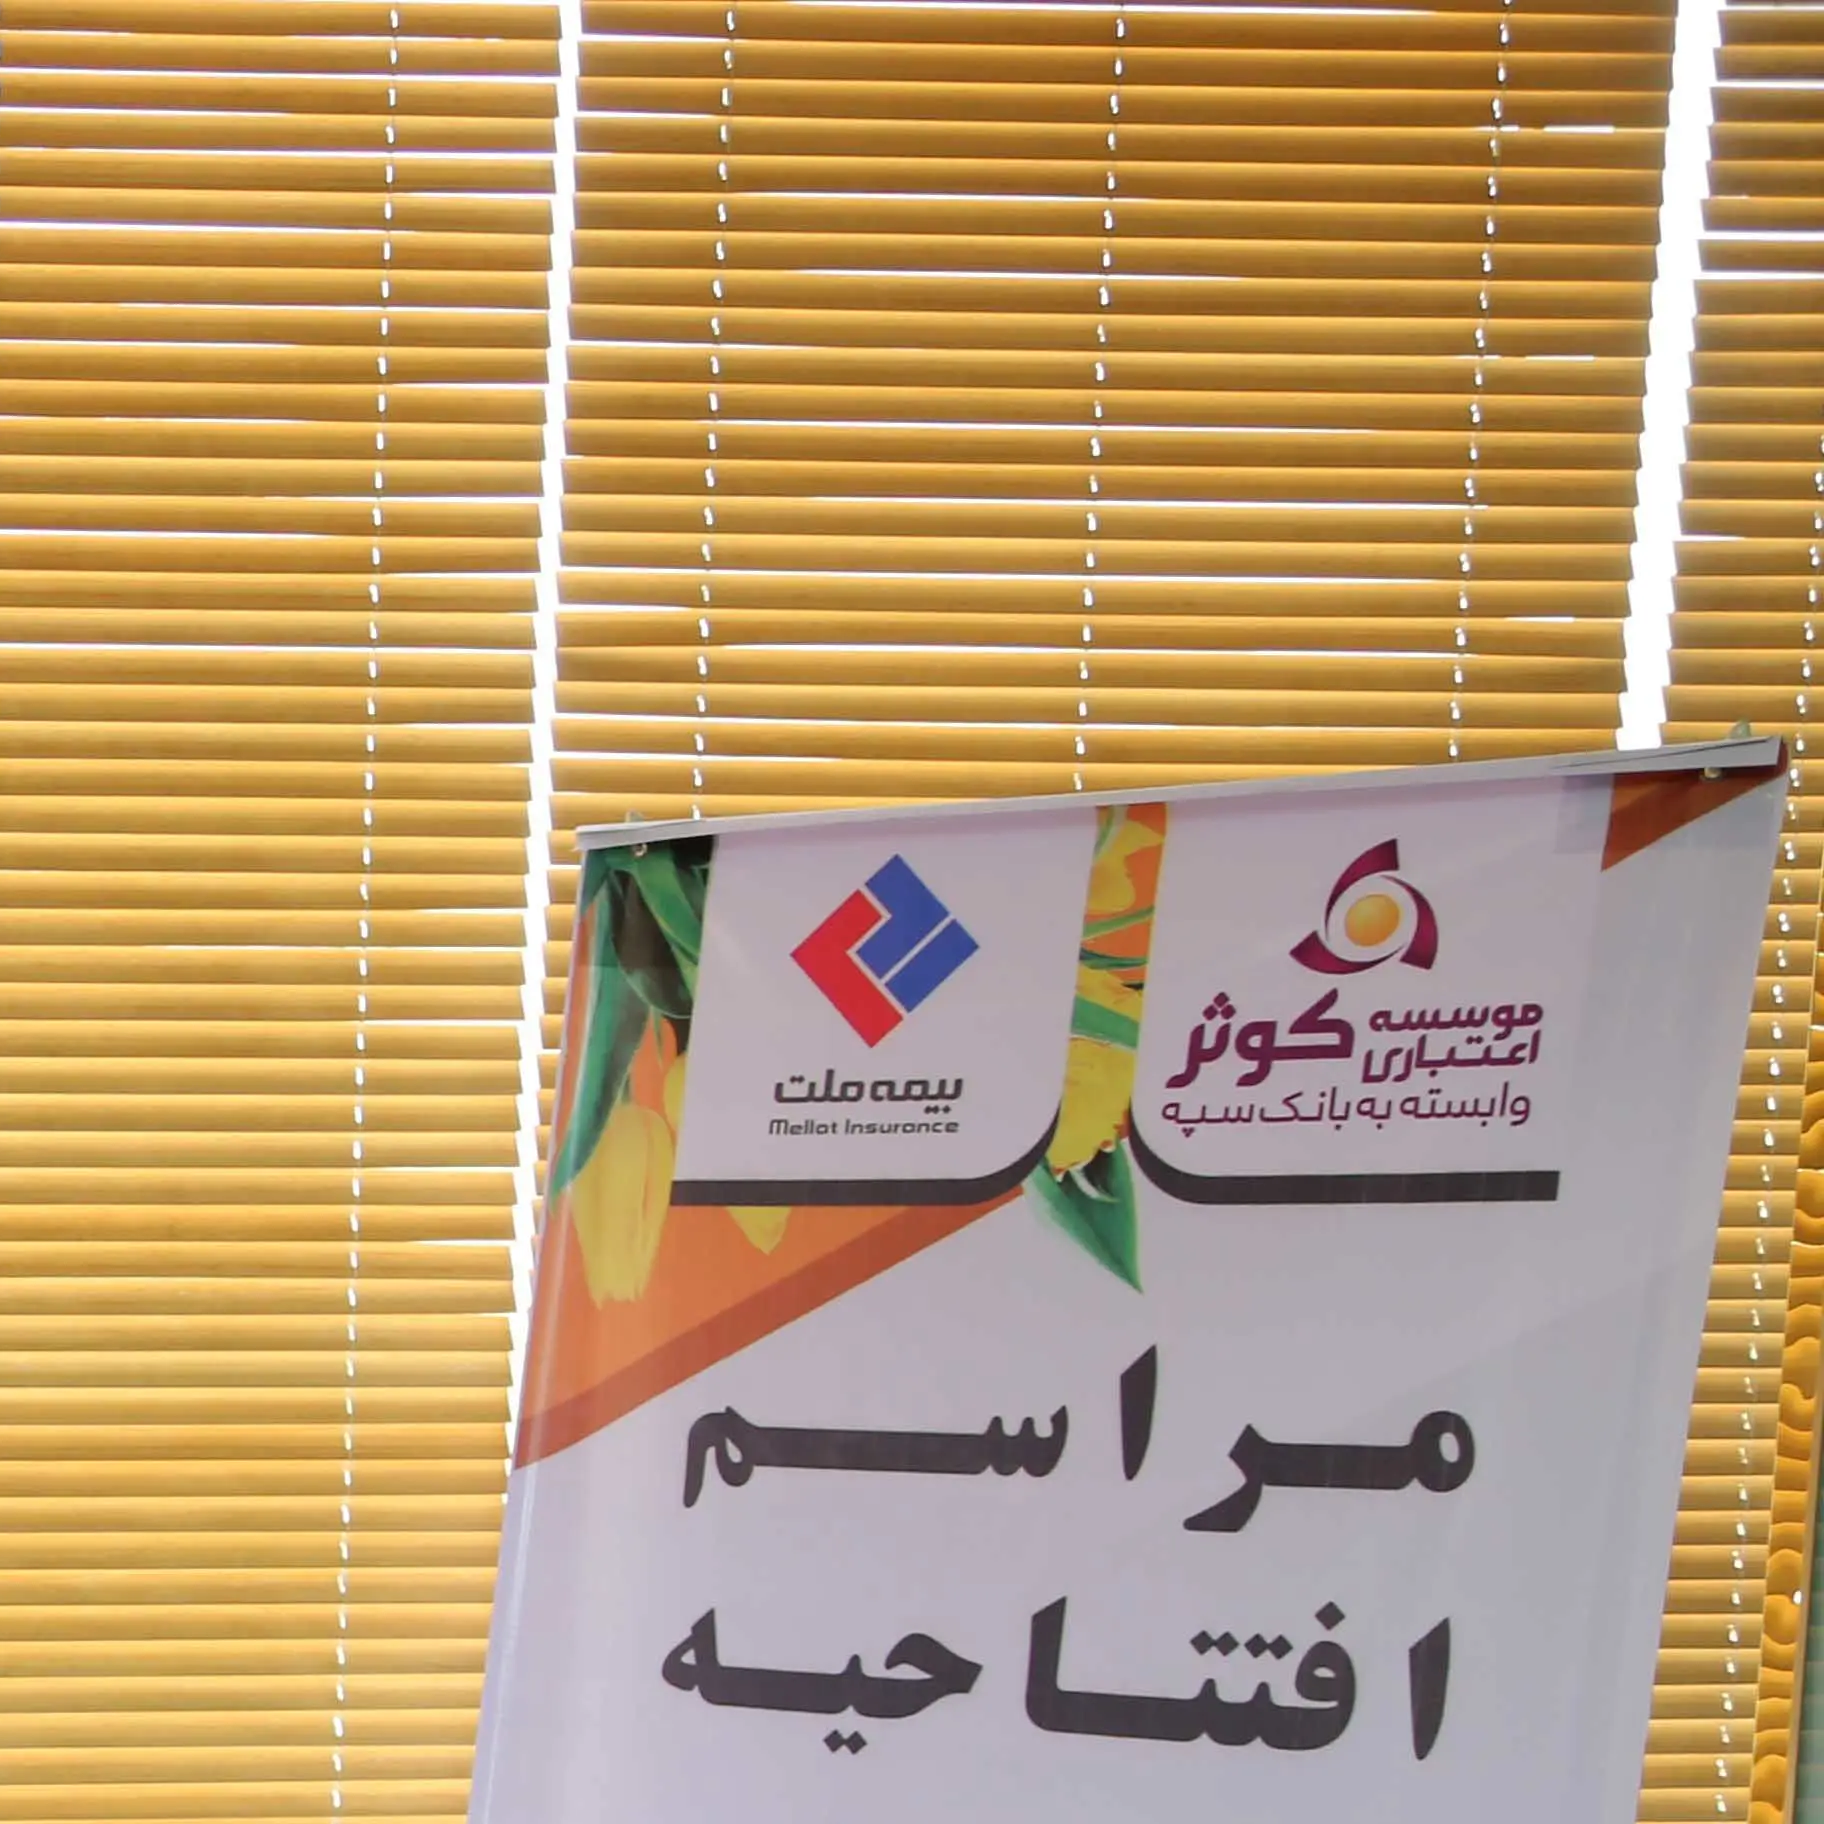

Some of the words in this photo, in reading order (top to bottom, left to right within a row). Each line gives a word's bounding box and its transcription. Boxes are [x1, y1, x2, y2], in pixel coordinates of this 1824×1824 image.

[1165, 988, 1356, 1090] کوثر
[1369, 1003, 1543, 1042] موسسه
[1360, 1028, 1543, 1084] اعتباری
[773, 1068, 866, 1104] ملت
[869, 1077, 964, 1116] بیمه
[1399, 1080, 1532, 1128] وابسته
[768, 1118, 839, 1136] Mellat
[844, 1118, 960, 1135] Insurance
[1161, 1101, 1255, 1139] سپه
[1258, 1086, 1352, 1131] بانک
[1355, 1097, 1393, 1131] به
[683, 1344, 1476, 1534] مراسم
[661, 1596, 1451, 1761] افتتاحیه
